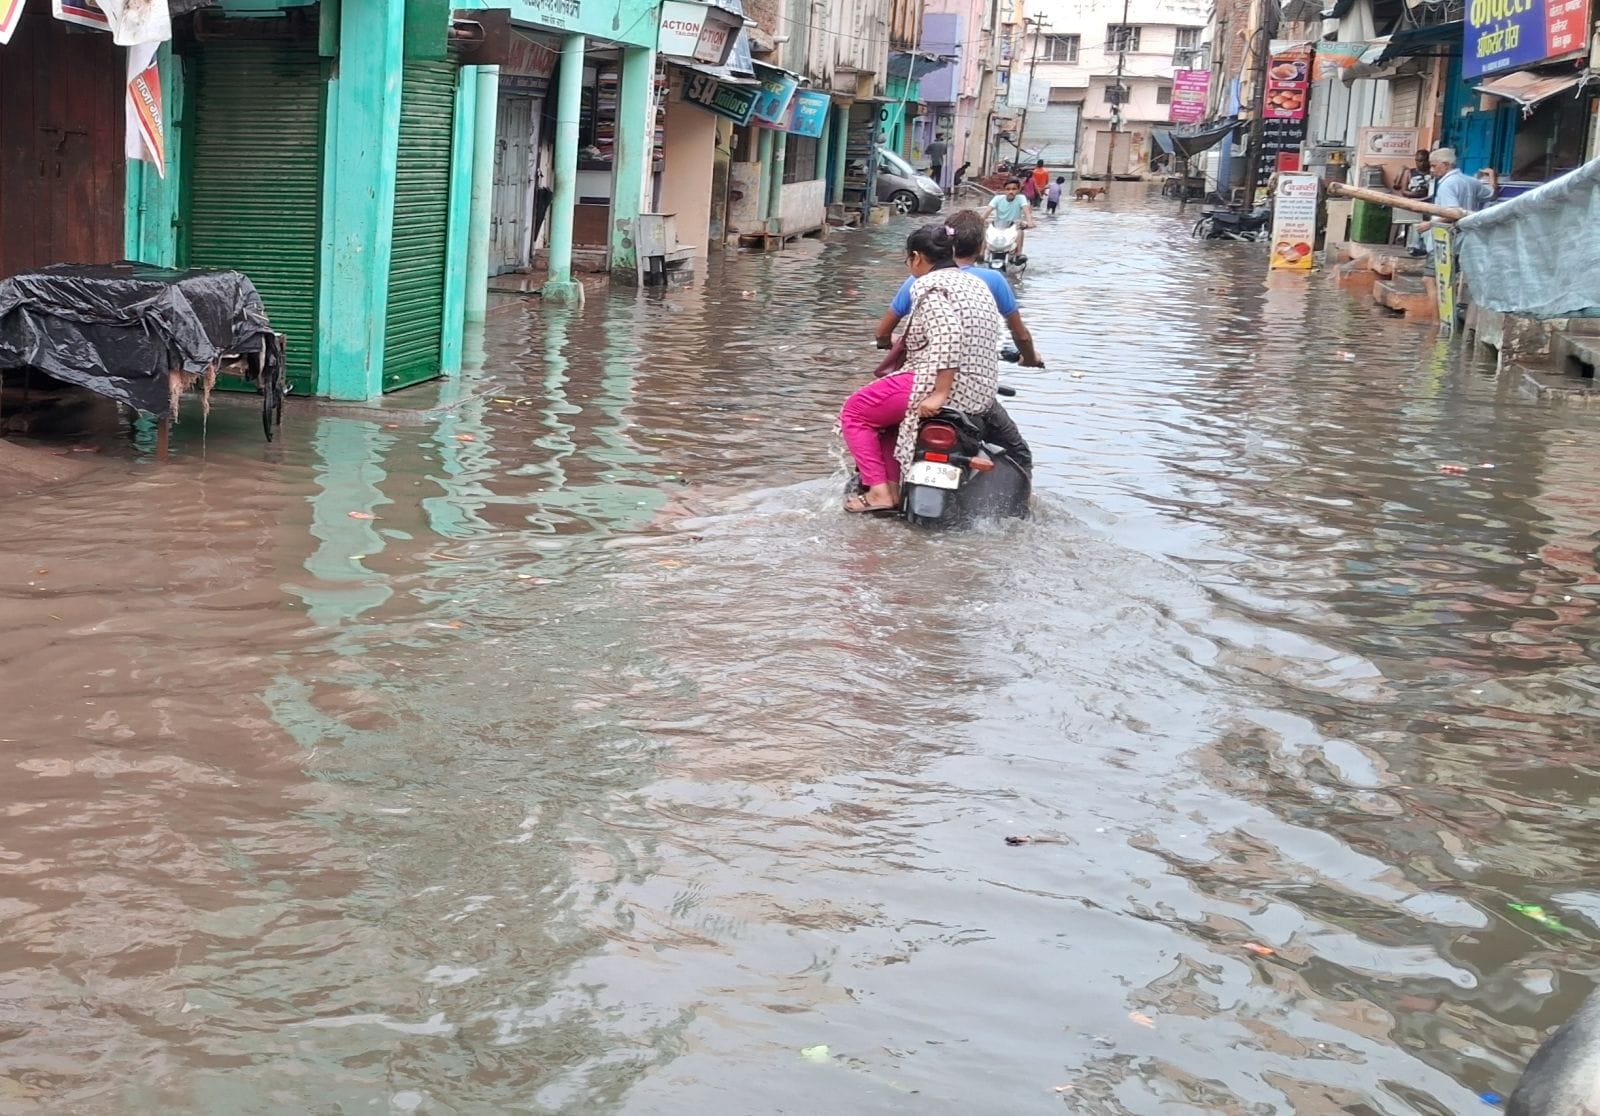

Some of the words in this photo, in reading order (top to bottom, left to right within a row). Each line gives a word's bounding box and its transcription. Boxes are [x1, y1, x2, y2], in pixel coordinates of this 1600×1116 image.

[662, 20, 700, 32] ACTION
[700, 28, 726, 45] CTION
[714, 87, 748, 114] Tailors
